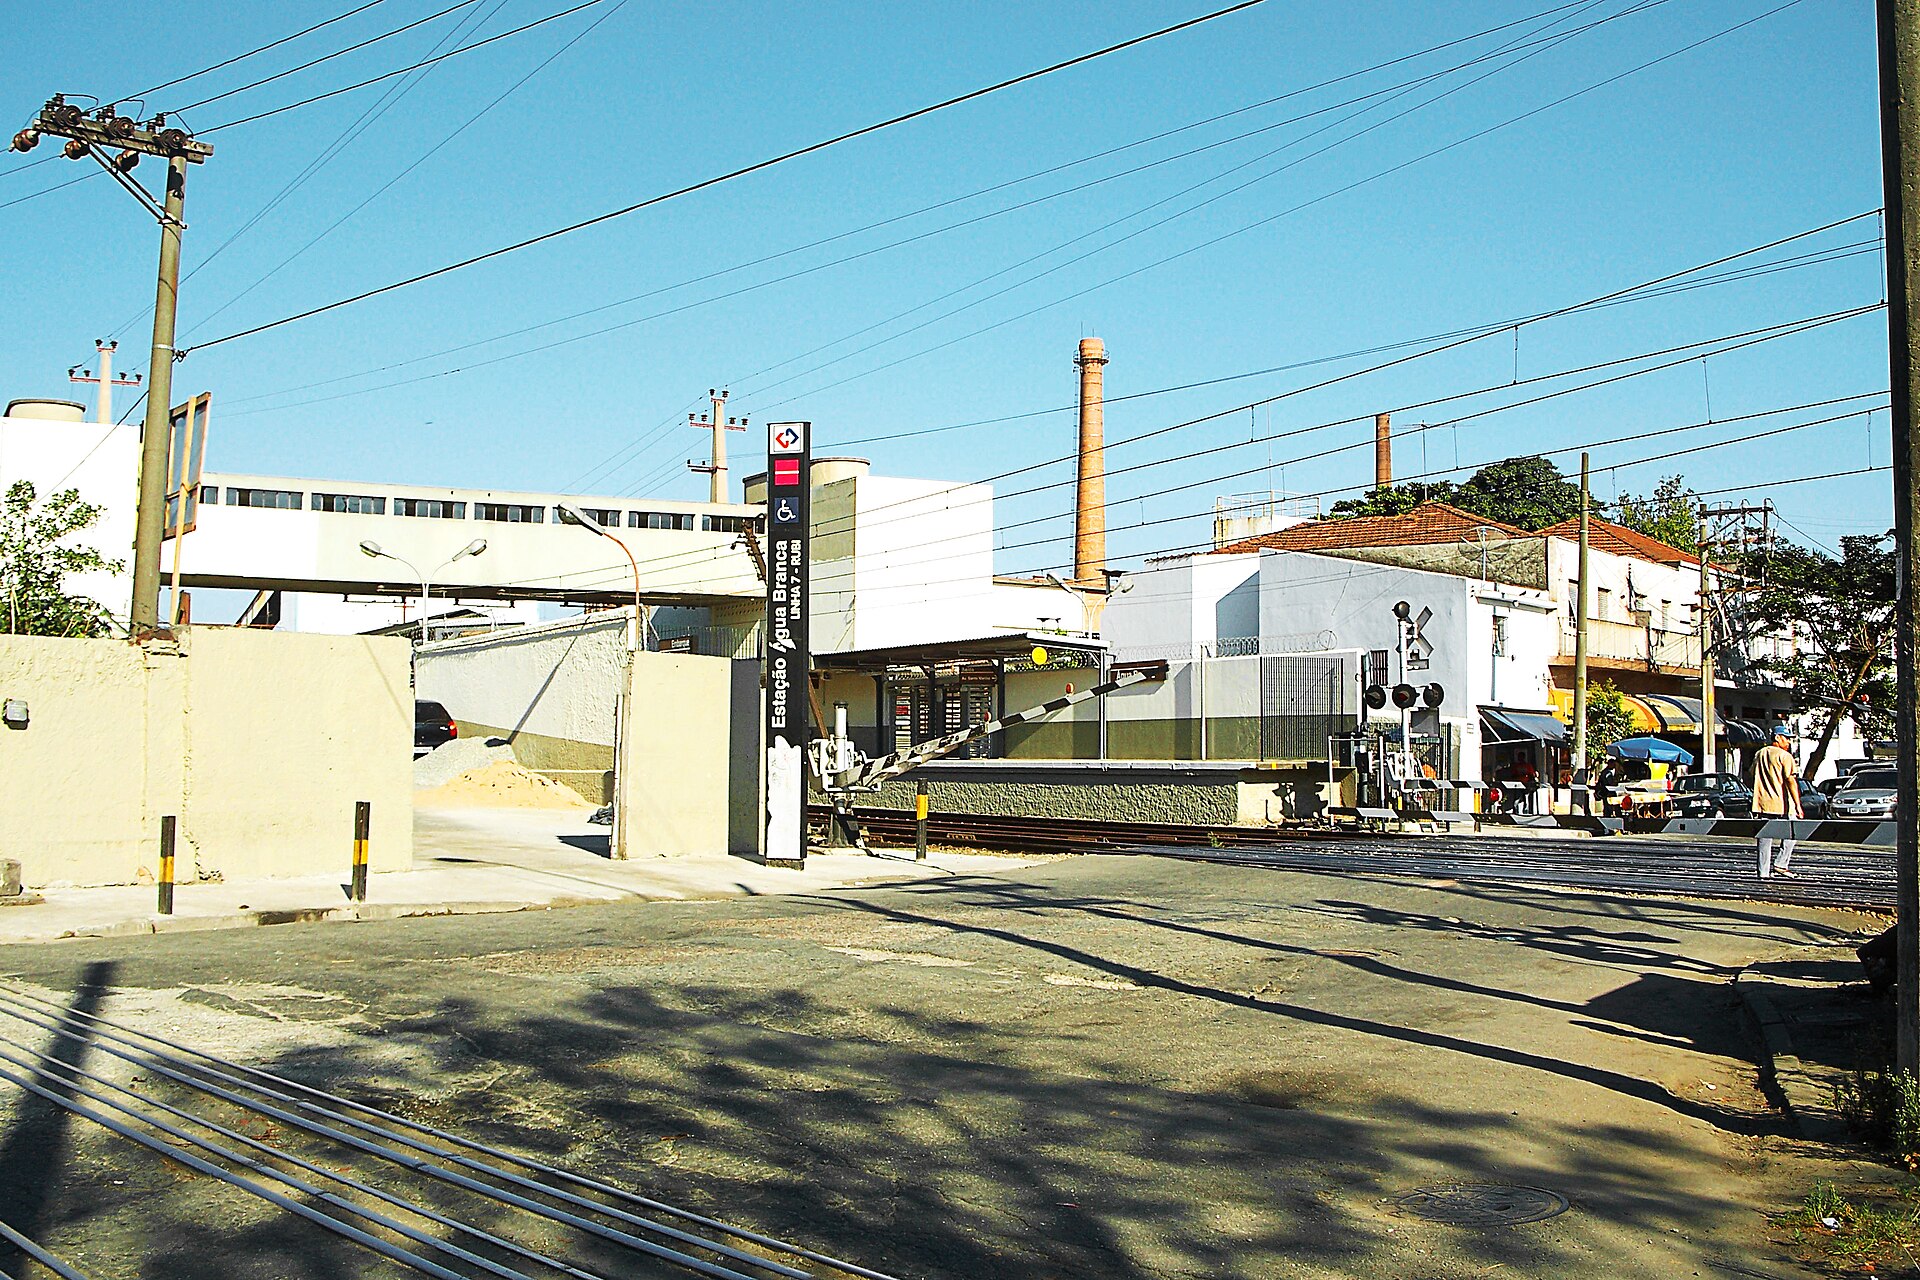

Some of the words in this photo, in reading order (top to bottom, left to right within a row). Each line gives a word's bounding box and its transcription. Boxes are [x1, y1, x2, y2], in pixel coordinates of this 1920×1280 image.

[790, 540, 802, 566] RUBI
[772, 540, 788, 602] Branca
[790, 575, 801, 584] 7
[790, 585, 801, 620] LINHA
[771, 658, 790, 728] Estação
